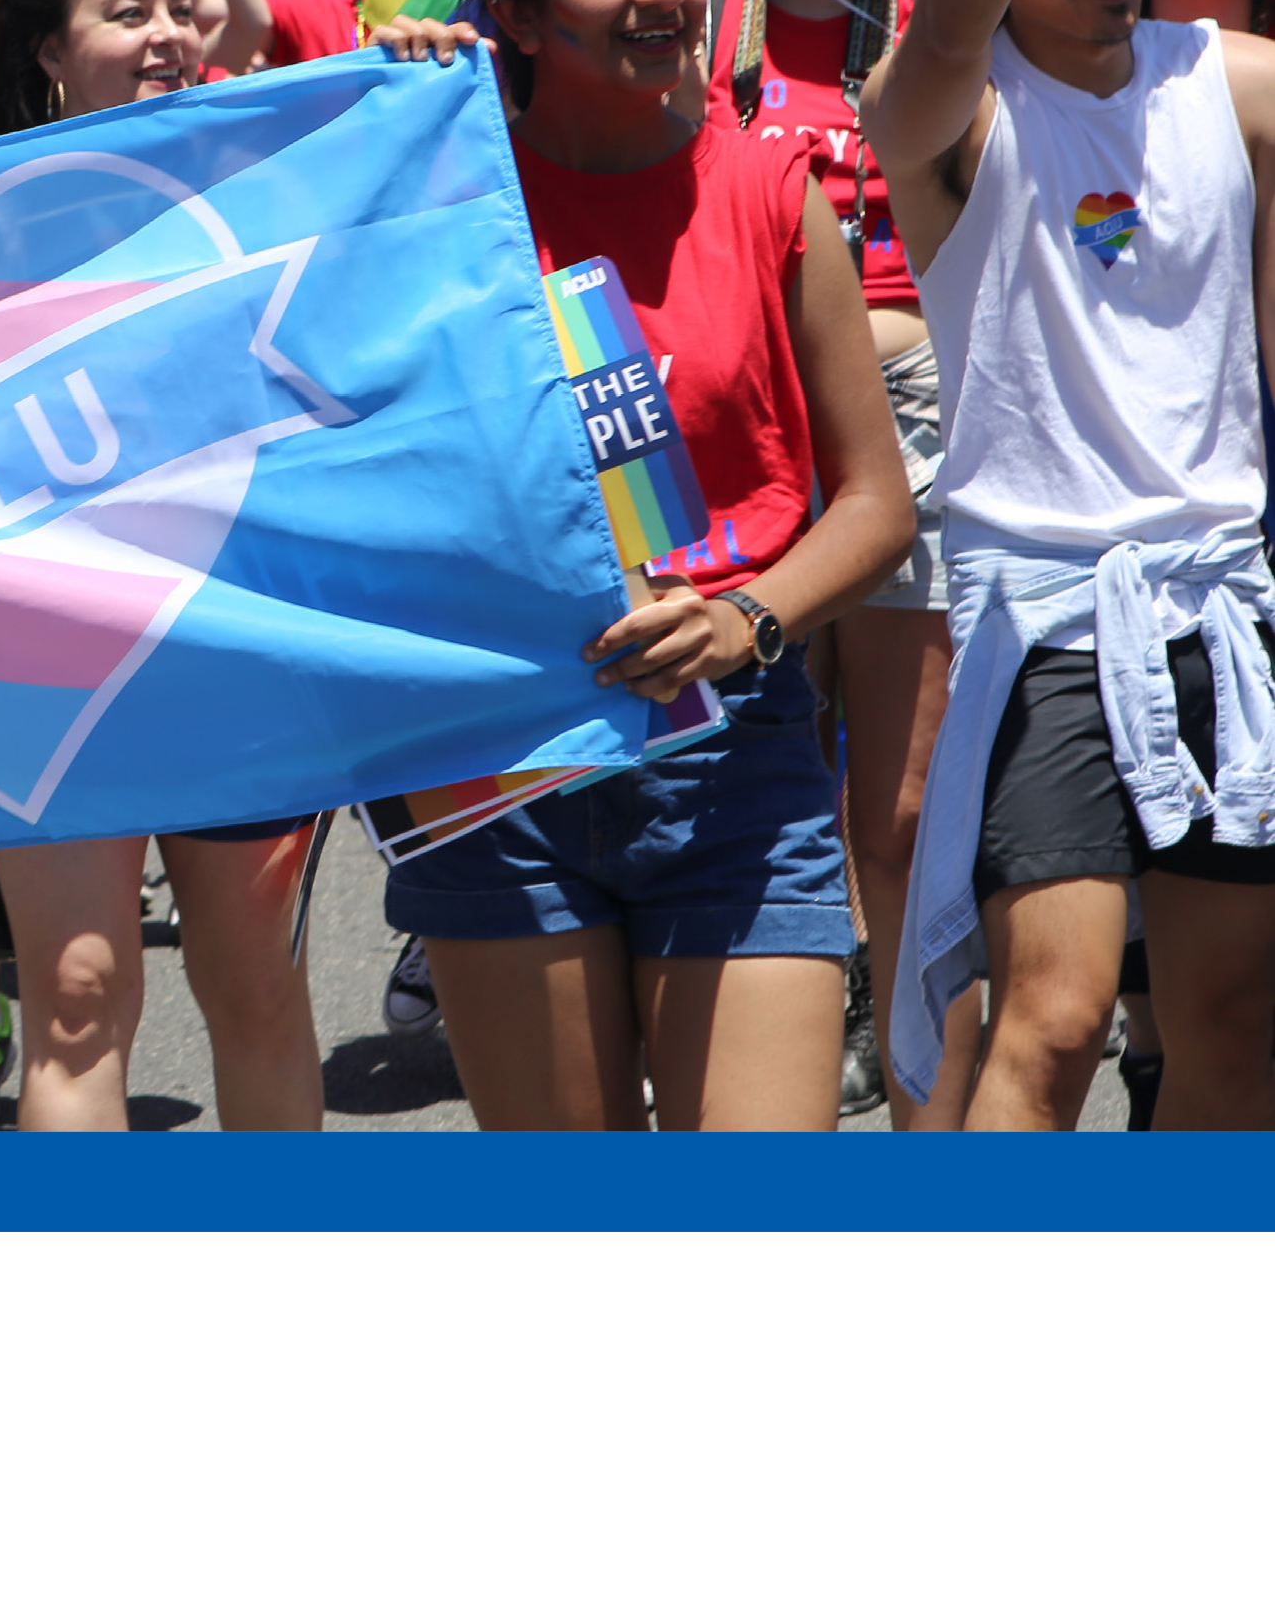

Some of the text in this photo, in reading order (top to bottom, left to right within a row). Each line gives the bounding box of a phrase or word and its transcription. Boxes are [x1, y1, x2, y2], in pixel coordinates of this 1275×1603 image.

[560, 266, 608, 298] ACLU
[571, 362, 651, 412] THE
[585, 393, 669, 461] PLE
